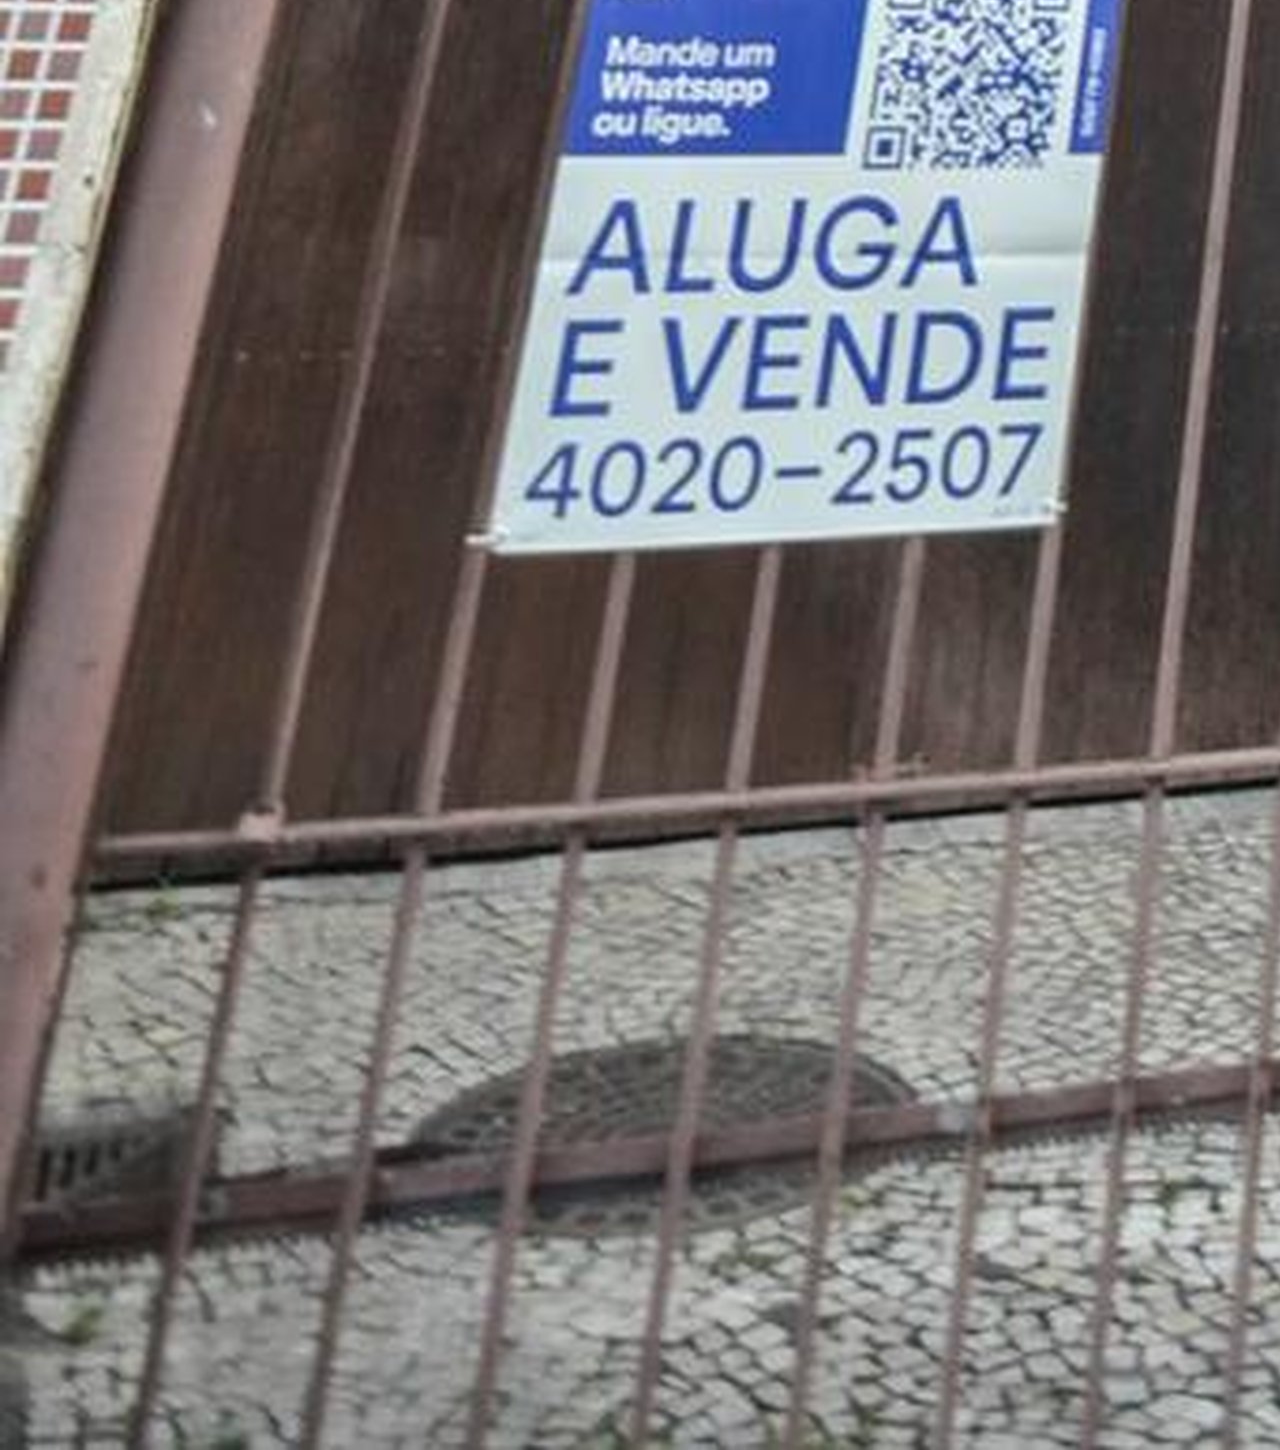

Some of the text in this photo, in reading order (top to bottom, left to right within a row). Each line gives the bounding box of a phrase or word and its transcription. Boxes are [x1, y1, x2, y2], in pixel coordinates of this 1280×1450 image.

[606, 35, 777, 68] Mande um
[602, 70, 771, 109] Whatsapp
[592, 104, 732, 144] ou ligue.
[566, 195, 979, 295] ALUGA
[547, 307, 1057, 418] E VENDE
[525, 424, 1045, 519] 4020-2507
